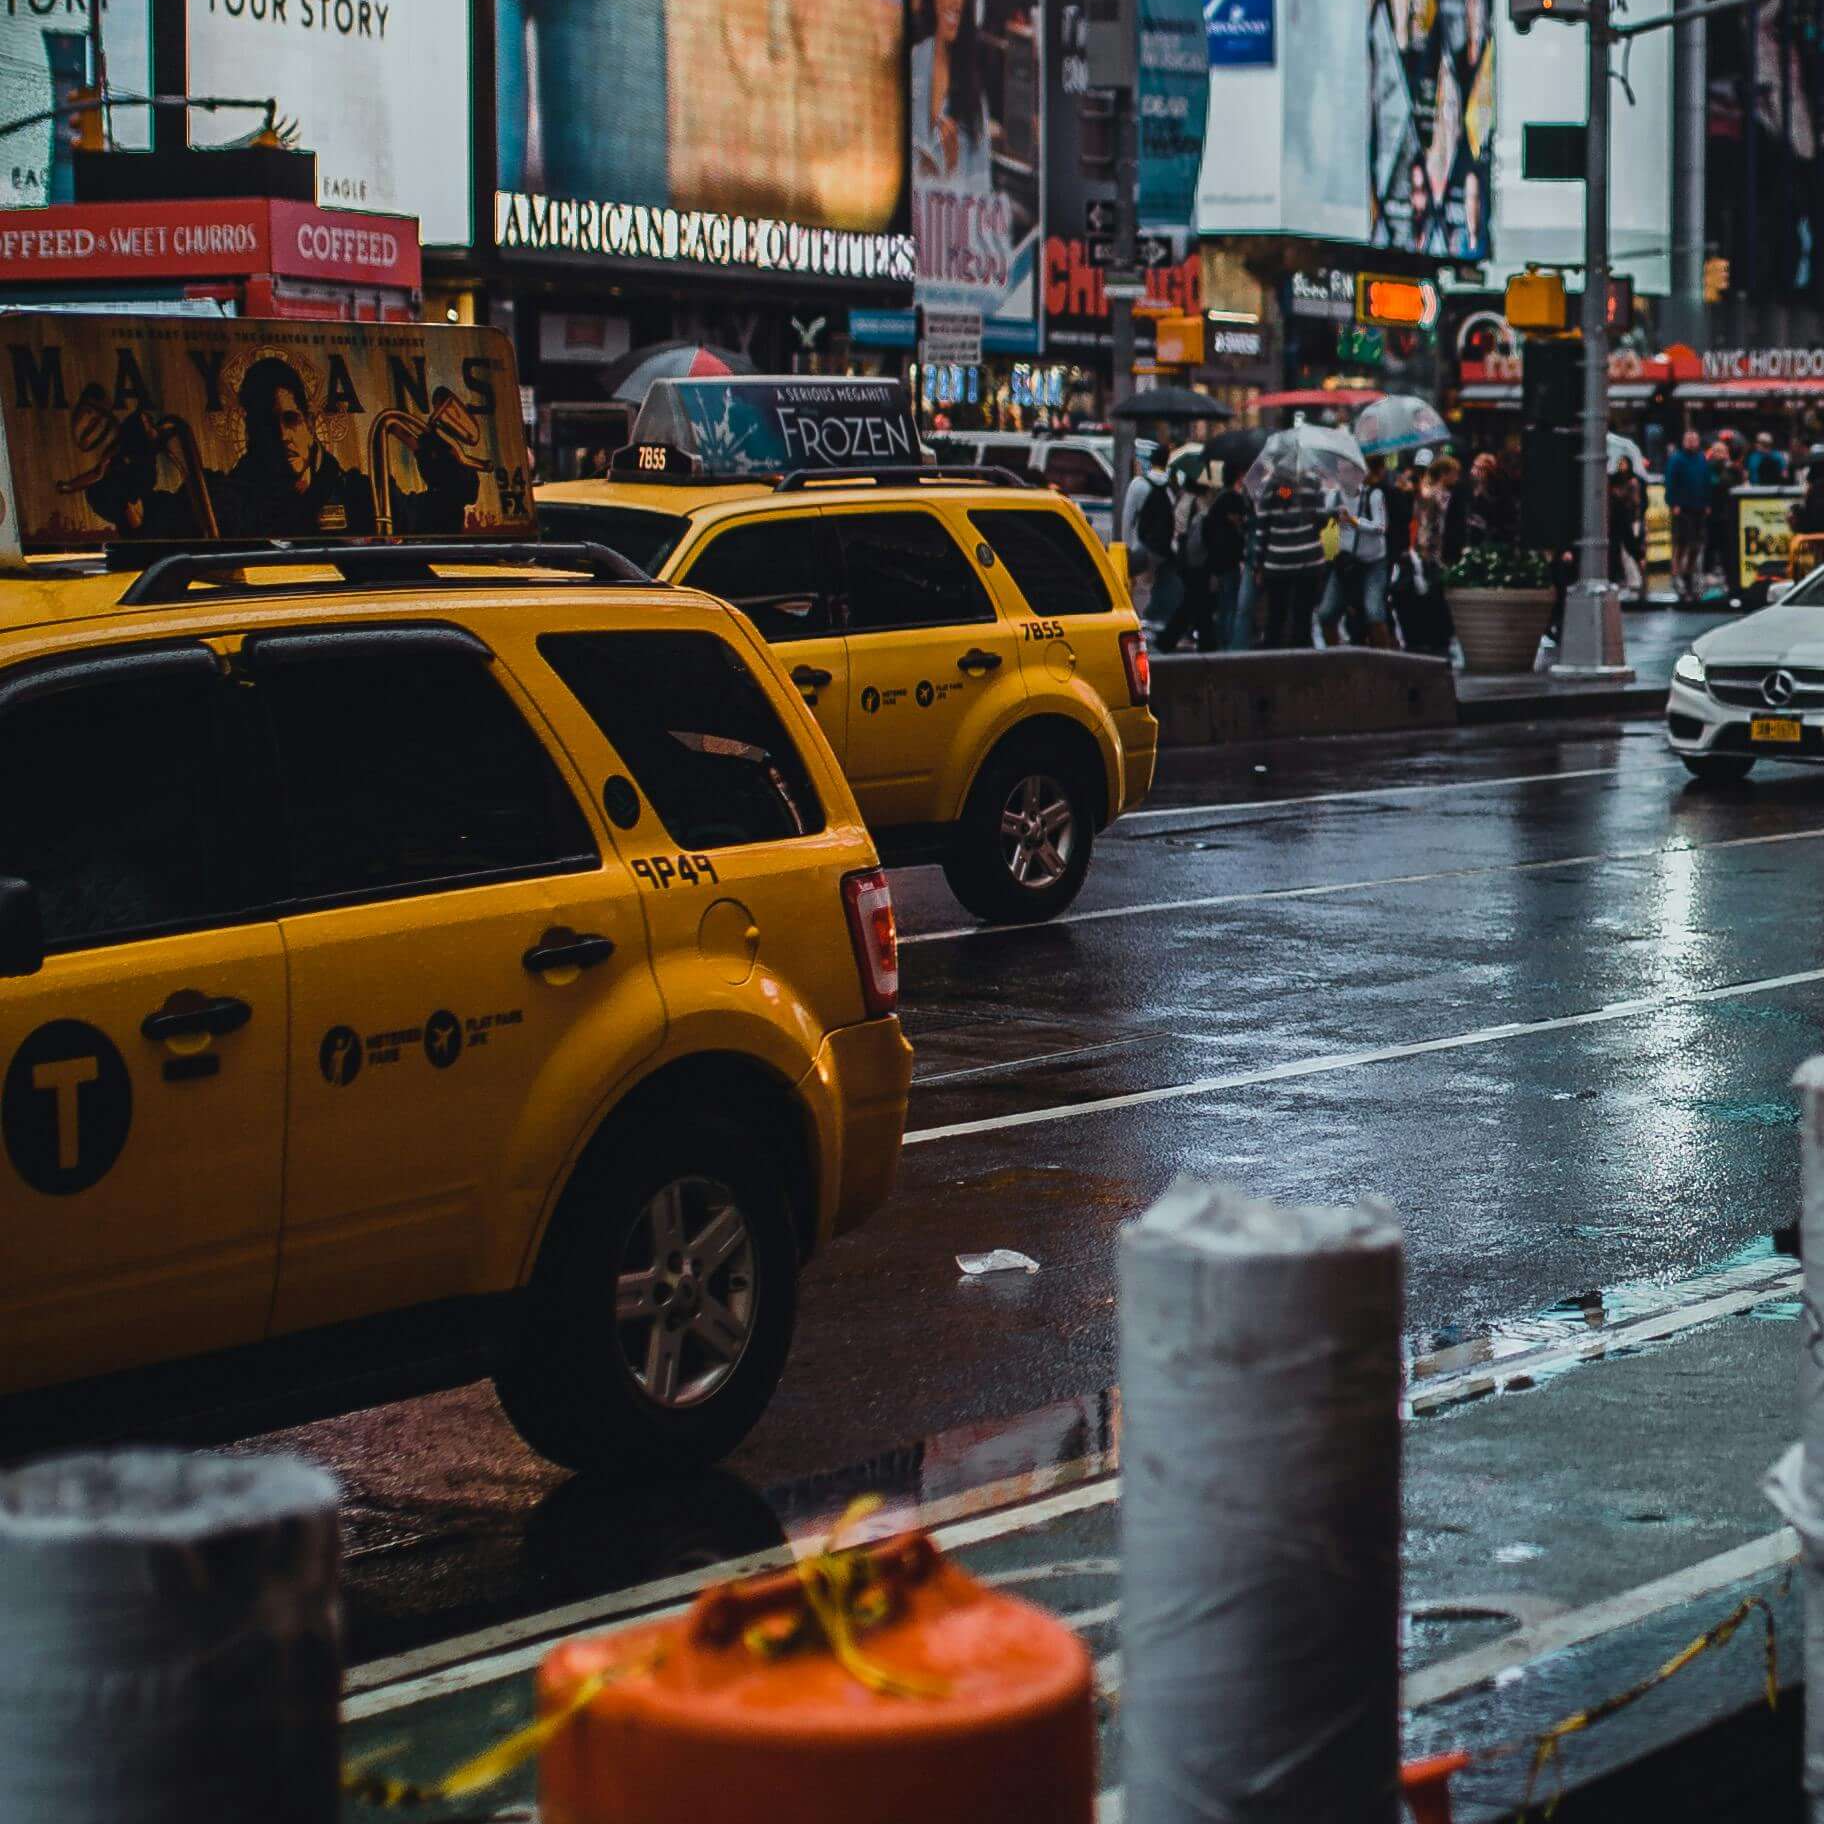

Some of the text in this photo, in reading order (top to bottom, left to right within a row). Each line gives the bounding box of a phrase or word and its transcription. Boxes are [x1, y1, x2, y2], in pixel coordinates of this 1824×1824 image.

[322, 176, 367, 200] EAGLE
[109, 225, 169, 257] SWEET
[173, 222, 257, 255] CHURROS
[297, 222, 398, 267] COFFEED
[494, 188, 679, 259] AMERICAN
[7, 343, 500, 416] MAYANS
[776, 385, 890, 404] A SERIOUS MEGAHIT!
[775, 406, 911, 468] FROZEN
[630, 854, 721, 890] 9P49
[31, 1054, 101, 1170] T
